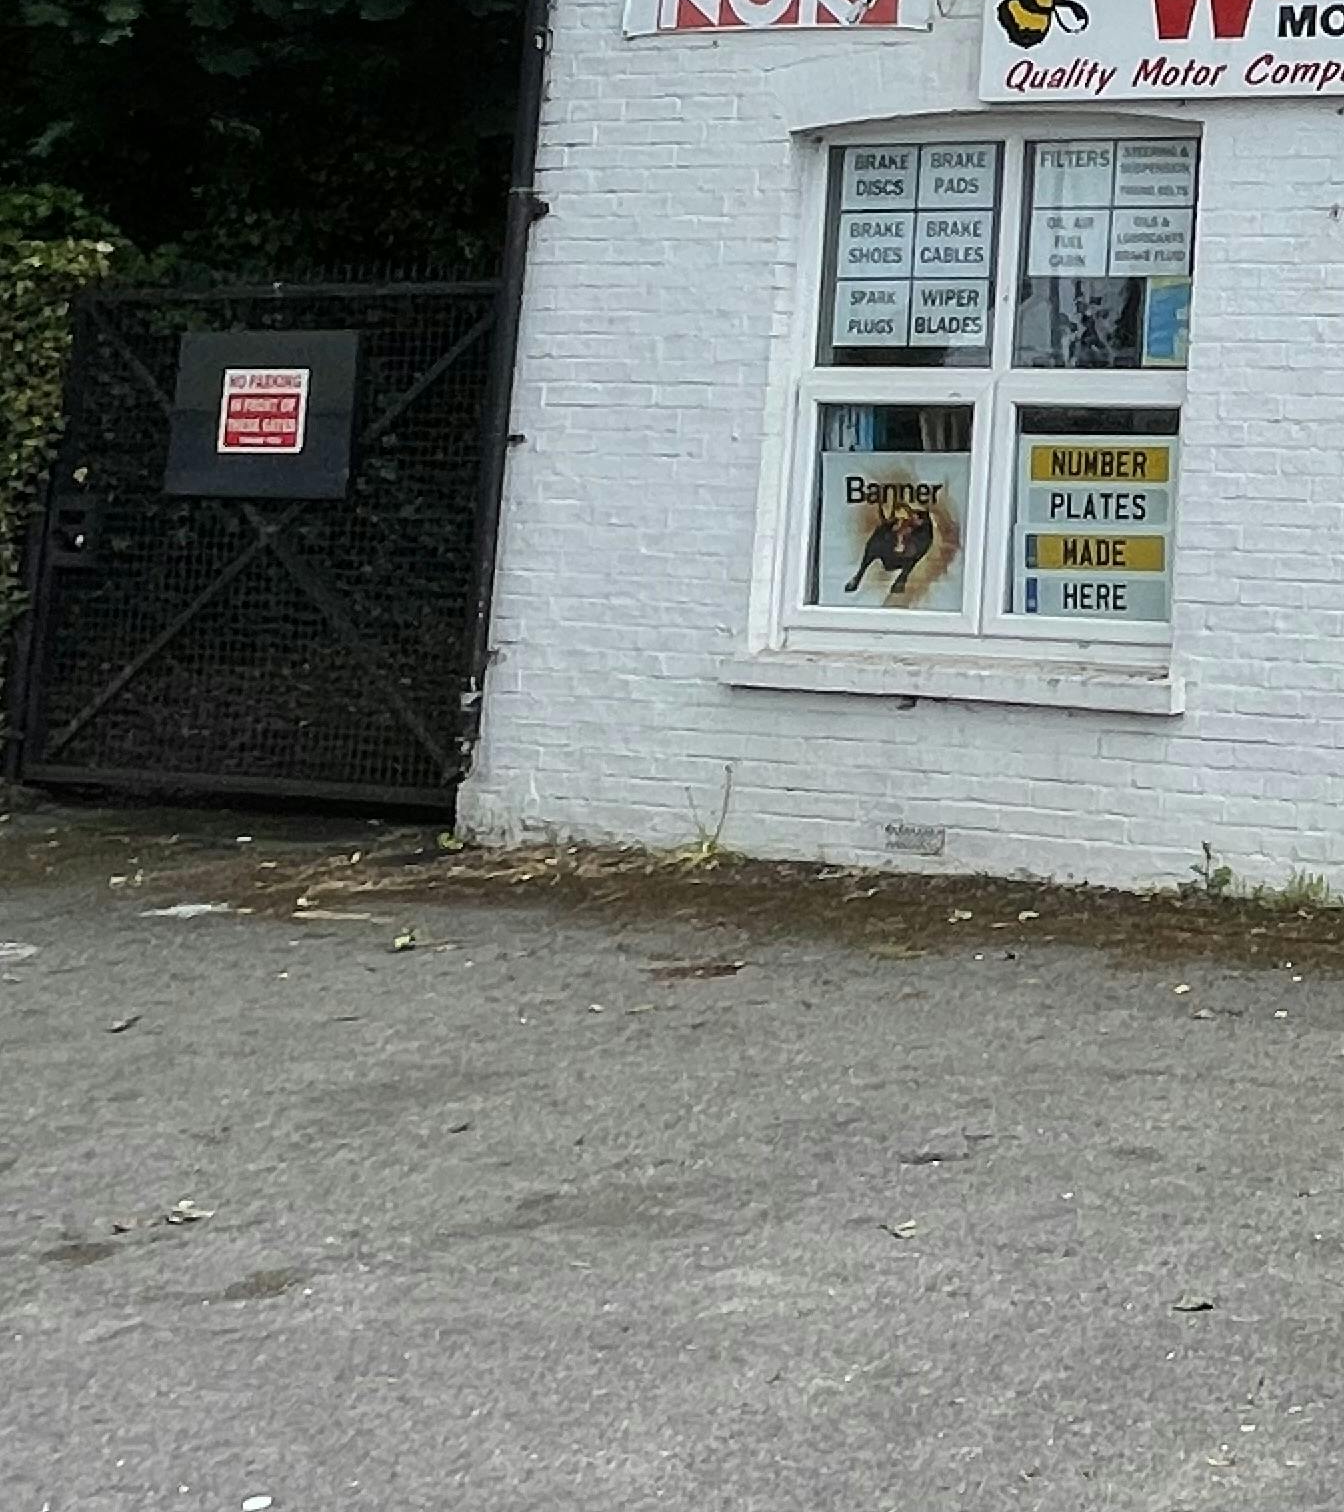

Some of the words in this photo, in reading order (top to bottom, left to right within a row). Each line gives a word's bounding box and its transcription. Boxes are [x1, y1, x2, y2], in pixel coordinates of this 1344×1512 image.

[1005, 56, 1116, 93] Quality
[1133, 55, 1226, 88] Motor
[854, 153, 910, 171] BRAKE
[930, 150, 987, 169] BRAKE
[1040, 150, 1110, 168] FILTERS
[856, 178, 904, 196] DISCS
[934, 177, 979, 194] PADS
[850, 221, 905, 238] BRAKE
[926, 220, 982, 238] BRAKE
[848, 246, 903, 264] SHOES
[920, 245, 984, 264] CABLES
[850, 290, 896, 305] SPARK
[922, 288, 979, 307] WIPER
[847, 318, 894, 334] PLUGS
[915, 316, 982, 334] BLADES
[1051, 450, 1148, 477] NUMBER
[846, 476, 943, 505] Banner
[1050, 492, 1146, 520] PLATES
[1062, 539, 1126, 566] MADE
[1062, 583, 1128, 610] HERE
